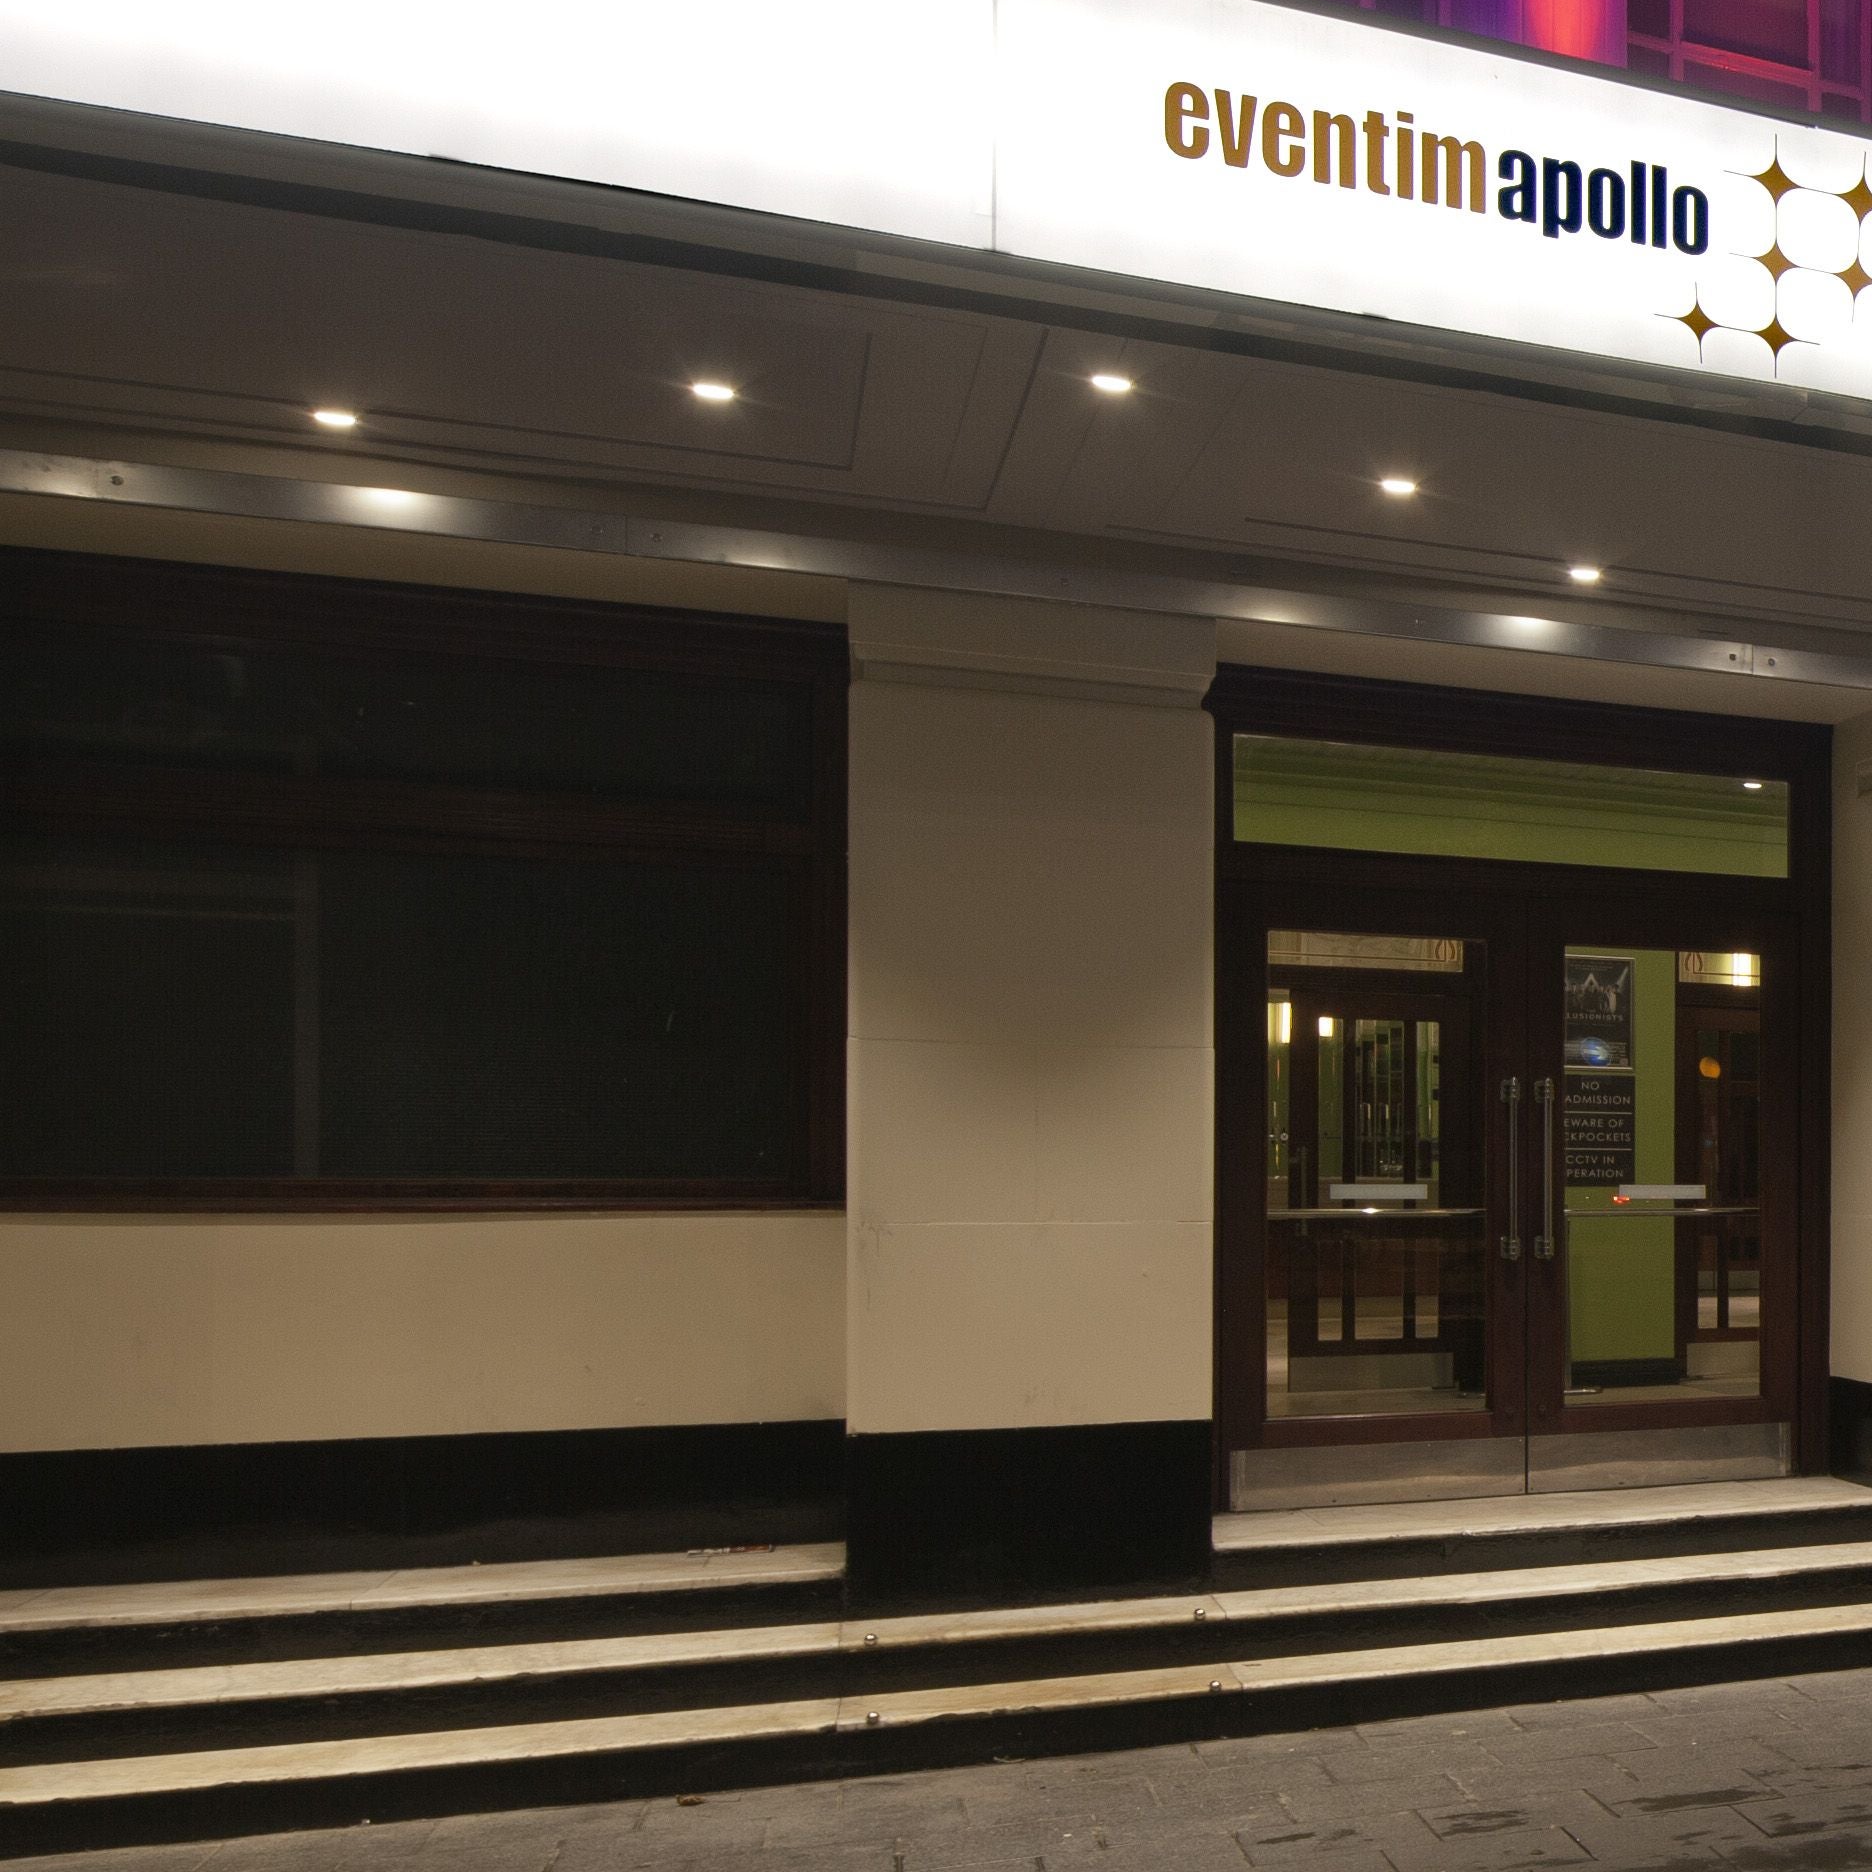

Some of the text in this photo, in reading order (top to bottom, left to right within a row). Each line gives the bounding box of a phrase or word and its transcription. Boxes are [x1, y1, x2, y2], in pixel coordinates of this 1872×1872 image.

[1164, 81, 1709, 256] eventimapollo
[1581, 1081, 1600, 1091] NO
[1565, 1095, 1631, 1105] ADMISSION
[1564, 1118, 1624, 1129] EWARE OF
[1564, 1132, 1631, 1143] KPOCKETS
[1565, 1155, 1615, 1165] CCTV IN
[1566, 1168, 1624, 1178] PERATION
